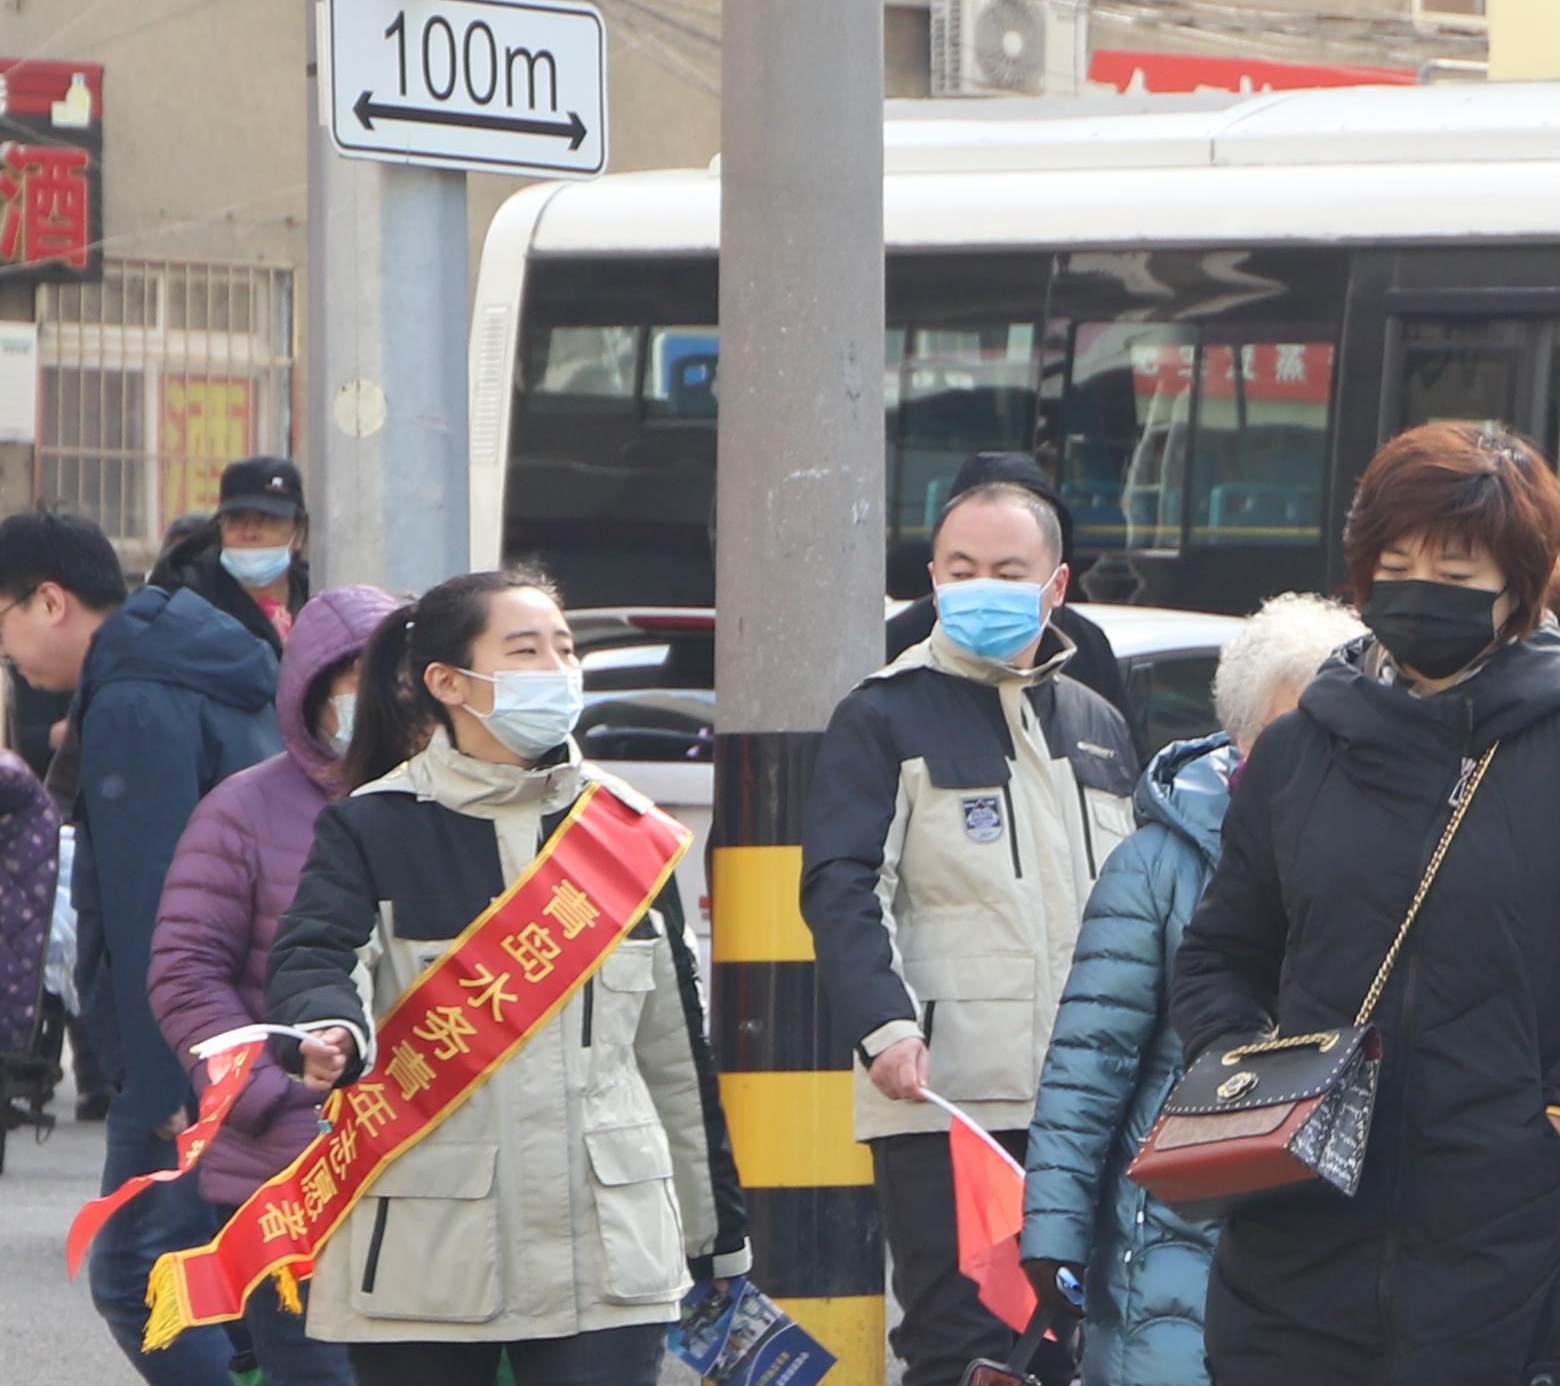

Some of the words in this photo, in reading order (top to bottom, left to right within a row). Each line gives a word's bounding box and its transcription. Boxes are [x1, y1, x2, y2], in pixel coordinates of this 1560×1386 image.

[384, 9, 558, 112] 100m
[257, 878, 601, 1244] 青岛水务青年志愿者
